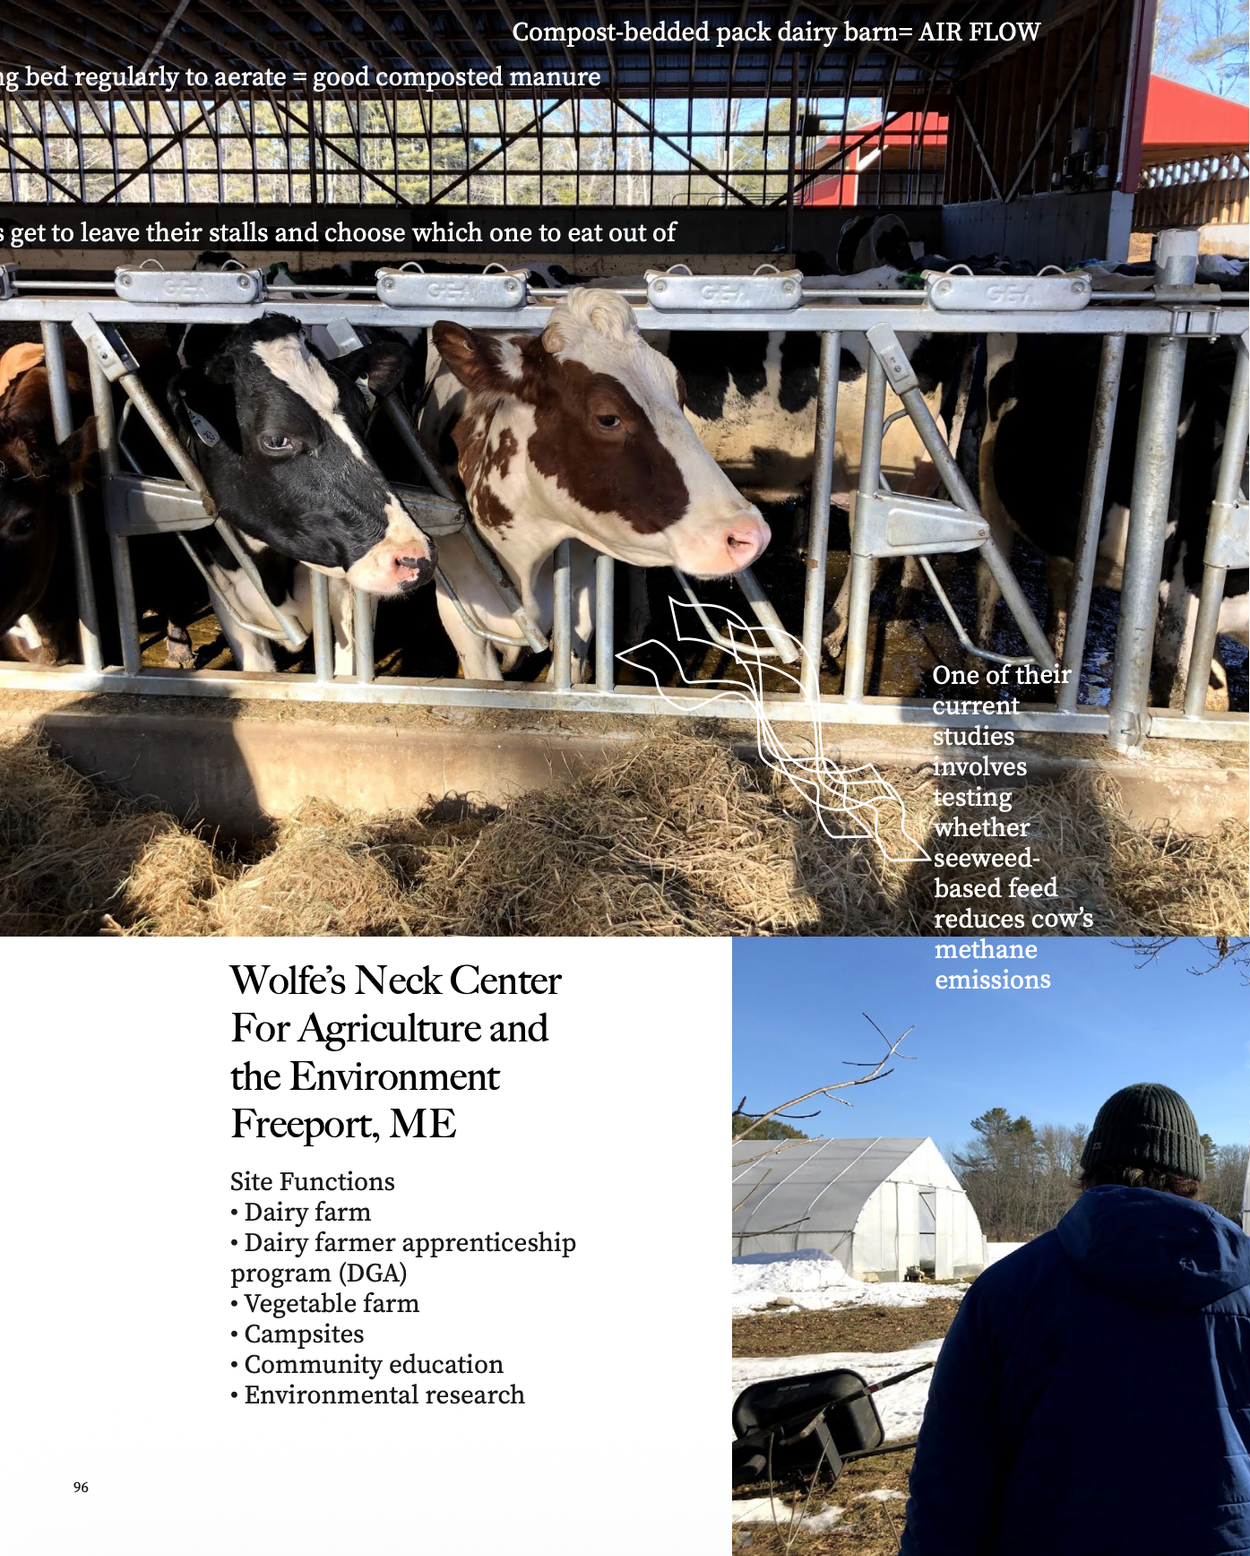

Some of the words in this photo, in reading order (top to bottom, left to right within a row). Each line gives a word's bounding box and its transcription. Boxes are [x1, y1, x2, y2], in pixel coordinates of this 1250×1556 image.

[228, 964, 346, 995] Wolfe’s
[354, 964, 444, 995] Neck
[450, 964, 563, 995] Center
[231, 1012, 292, 1043] For
[296, 1011, 482, 1052] Agriculture
[489, 1012, 550, 1043] and
[230, 1060, 282, 1091] the
[289, 1060, 501, 1091] Environment
[231, 1108, 380, 1147] Freeport,
[389, 1107, 457, 1138] ME
[230, 1170, 273, 1192] Site
[279, 1170, 395, 1192] Functions
[244, 1200, 310, 1228] Dairy
[314, 1200, 372, 1222] farm
[244, 1231, 310, 1259] Dairy
[314, 1230, 397, 1252] farmer
[402, 1230, 577, 1258] apprenticeship
[230, 1267, 332, 1289] program
[339, 1261, 407, 1287] (DGA)
[243, 1291, 357, 1319] Vegetable
[363, 1291, 420, 1313] farm
[244, 1322, 365, 1350] Campsites
[244, 1353, 384, 1380] Community
[389, 1352, 505, 1374] education
[244, 1383, 419, 1405] Environmental
[425, 1383, 526, 1405] research
[73, 1481, 89, 1493] 96
